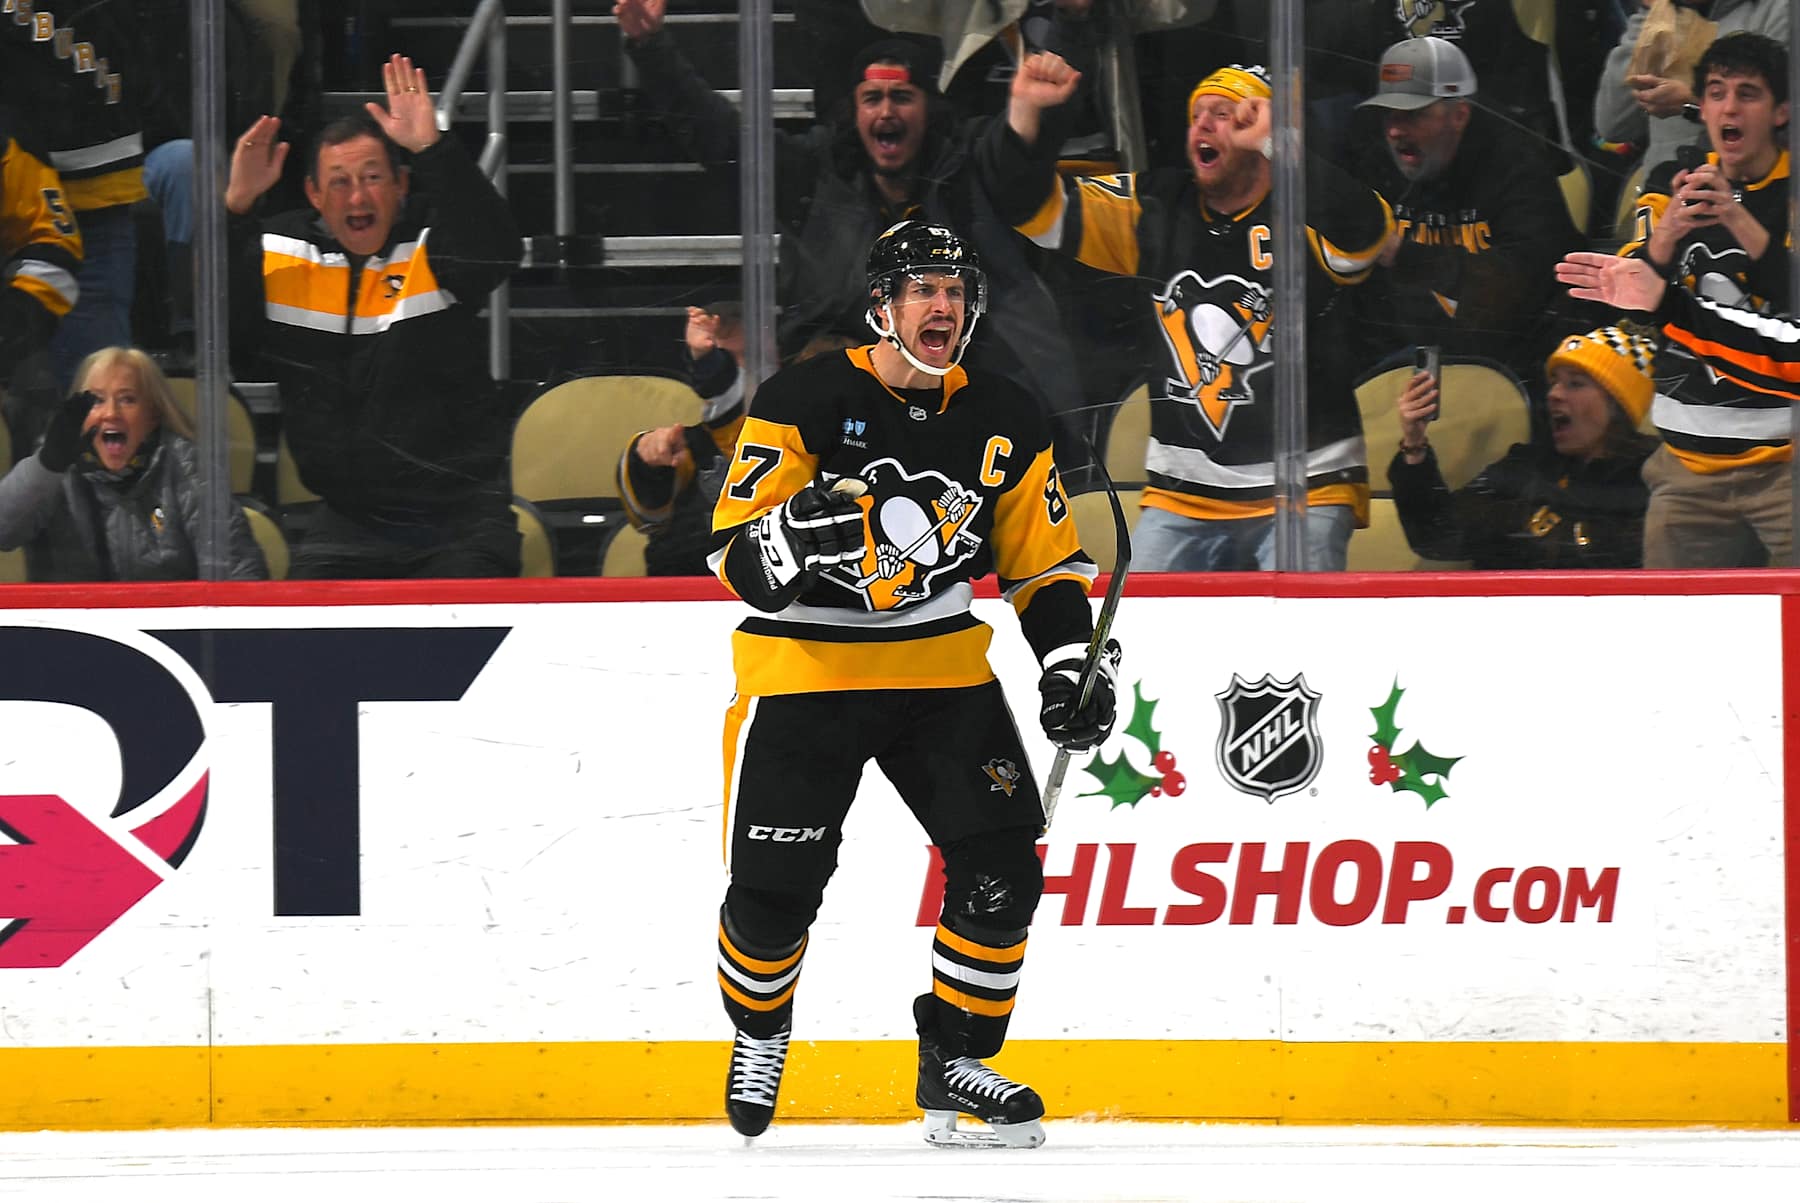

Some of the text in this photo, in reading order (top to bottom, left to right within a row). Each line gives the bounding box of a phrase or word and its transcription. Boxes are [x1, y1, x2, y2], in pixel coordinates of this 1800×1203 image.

[1249, 224, 1273, 270] C
[727, 442, 784, 501] 7
[979, 435, 1014, 487] C
[1042, 463, 1069, 527] 8
[1240, 707, 1302, 773] NHL
[747, 824, 827, 842] CCM
[947, 1091, 979, 1110] CCM
